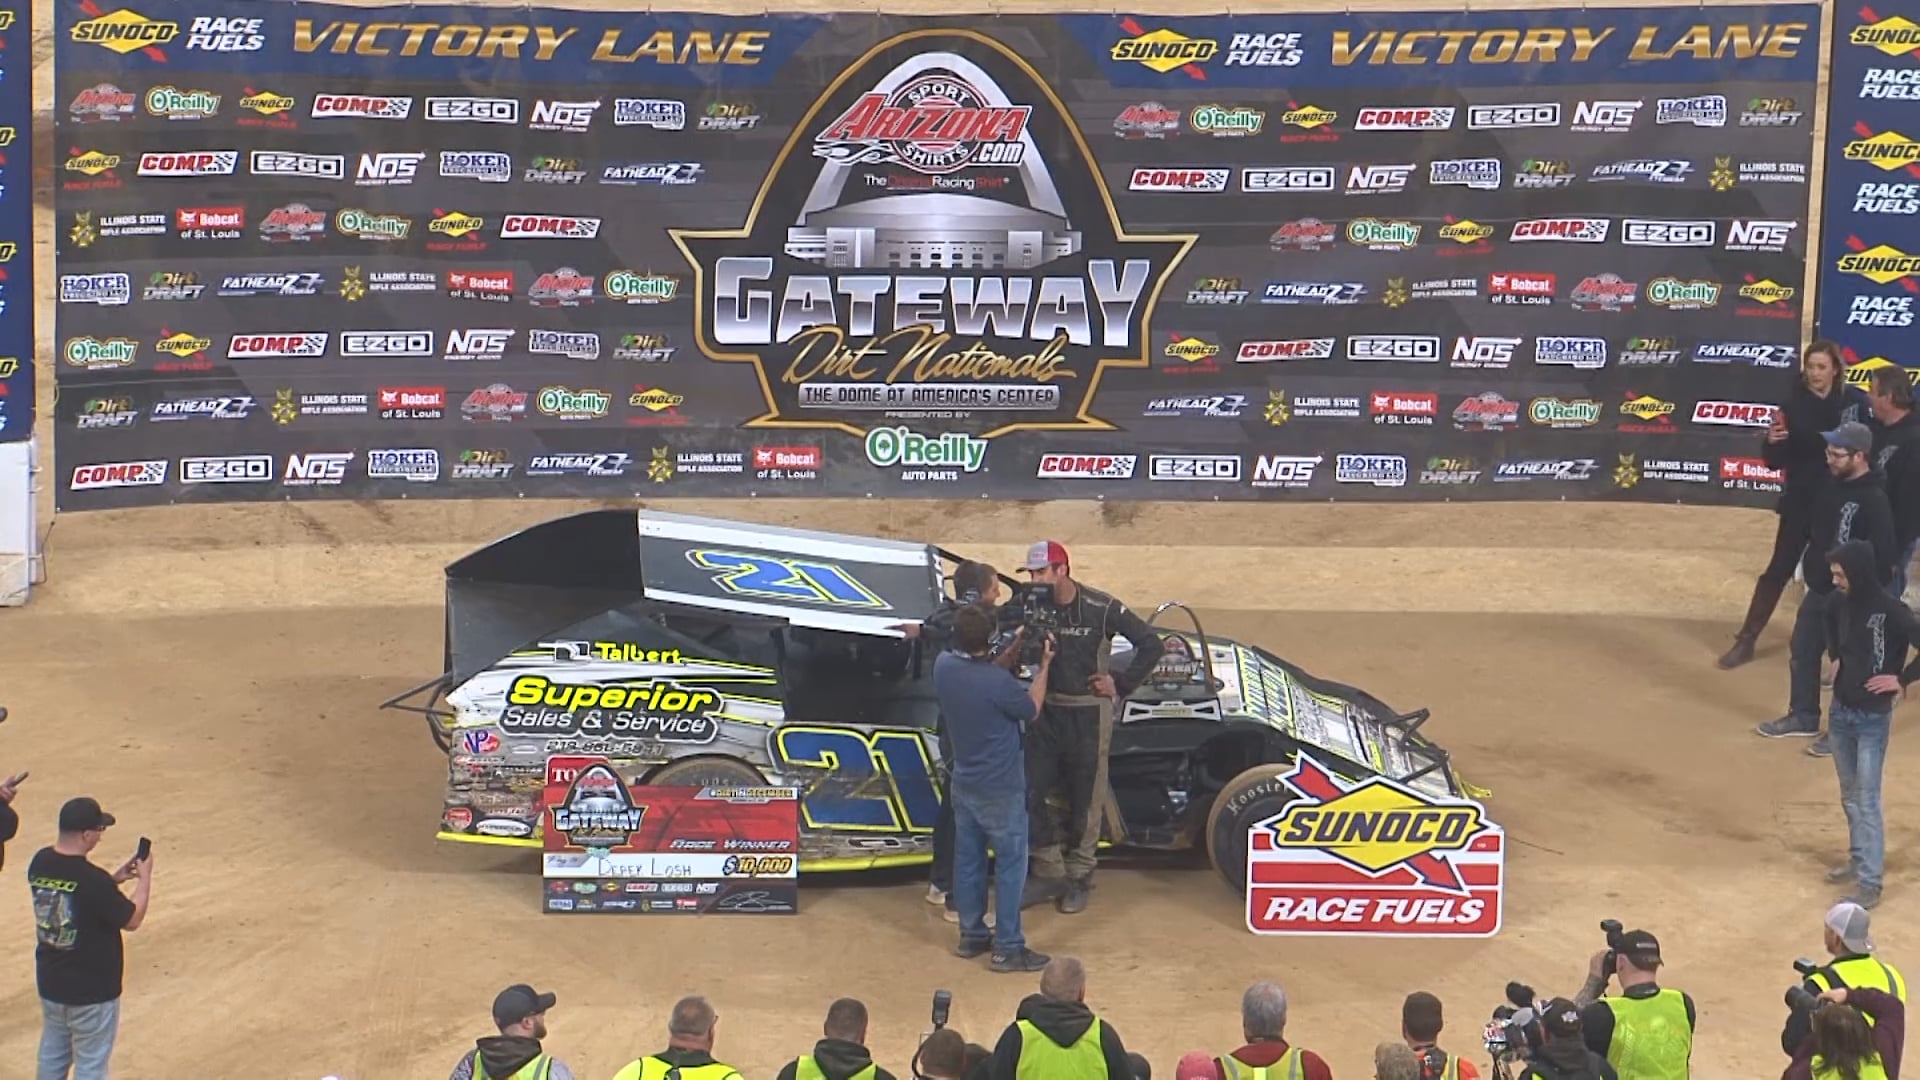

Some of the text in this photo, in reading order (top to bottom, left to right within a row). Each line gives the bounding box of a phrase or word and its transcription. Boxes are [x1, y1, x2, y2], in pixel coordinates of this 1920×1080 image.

[77, 22, 174, 40] SUNOCO
[190, 18, 262, 34] RACE
[186, 35, 264, 51] FUELS
[294, 19, 770, 65] VICTORY LANE
[1117, 42, 1213, 58] SUNOCO
[1230, 33, 1301, 49] RACE
[1332, 22, 1807, 65] VICTORY LANE
[1225, 49, 1301, 66] FUELS
[149, 90, 219, 115] O'Reilly
[908, 83, 969, 104] SPORT
[316, 98, 388, 112] COMP
[432, 104, 511, 118] EZGO
[533, 100, 593, 125] NOS
[1573, 100, 1635, 126] NOS
[822, 93, 1030, 142] ARIZONA
[1194, 108, 1262, 127] O'Reilly
[1361, 111, 1430, 126] COMP
[1474, 109, 1552, 123] EZGO
[902, 143, 969, 166] SHIRTS
[1848, 143, 1920, 159] SUNOC
[142, 155, 212, 171] COMP
[255, 156, 336, 174] EZGO
[356, 152, 416, 177] NOS
[864, 174, 887, 186] The
[932, 176, 975, 189] Racing
[1134, 172, 1203, 187] COMP
[1248, 171, 1325, 187] EZGO
[1347, 165, 1407, 187] NOS
[1857, 183, 1919, 198] RACE
[1852, 199, 1920, 214] FUELS
[200, 213, 239, 225] Bobcat
[339, 210, 409, 238] O'Reilly
[506, 217, 575, 232] COMP
[1350, 221, 1418, 242] O'Reilly
[1515, 222, 1584, 236] COMP
[1627, 225, 1708, 242] EZGO
[1729, 221, 1789, 244] NOS
[470, 276, 508, 289] Bobcat
[608, 272, 676, 296] O'Reilly
[1512, 279, 1549, 290] Bobcat
[1653, 282, 1717, 302] O'Reilly
[715, 256, 1151, 348] GATEWAY
[1851, 296, 1913, 311] RACE
[1846, 311, 1914, 326] FUELS
[233, 337, 302, 353] COMP
[347, 336, 426, 351] EZGO
[448, 329, 509, 353] NOS
[1242, 343, 1310, 357] COMP
[1353, 341, 1434, 357] EZGO
[1454, 337, 1514, 361] NOS
[67, 340, 135, 361] O'Reilly
[782, 325, 1077, 384] Dirt Nationals
[401, 393, 439, 405] Bobcat
[541, 388, 608, 412] O'Reilly
[805, 387, 1054, 402] THE DOME AT AMERICA'S CENTER
[382, 410, 394, 418] of
[414, 409, 441, 418] Louis
[1394, 399, 1432, 410] Bobcat
[1534, 402, 1599, 421] O'Reilly
[1698, 404, 1768, 420] COMP
[868, 427, 987, 471] O'Reilly
[286, 453, 347, 479] NOS
[776, 454, 814, 465] Bobcat
[1042, 457, 1113, 472] COMP
[1154, 460, 1235, 476] EZGO
[1255, 455, 1315, 480] NOS
[76, 466, 144, 482] COMP
[186, 461, 266, 479] EZGO
[902, 471, 958, 480] AUTO PARTS
[686, 549, 893, 610] 21
[595, 641, 682, 664] Talbert
[510, 676, 713, 712] Superior
[503, 706, 706, 734] Sales & Service
[465, 730, 489, 755] VP
[772, 726, 942, 832] 21
[556, 808, 641, 831] GATEWAY
[1285, 811, 1471, 842] SUNOCO
[722, 855, 793, 878] $10,000
[1264, 897, 1485, 924] RACE FUELS
